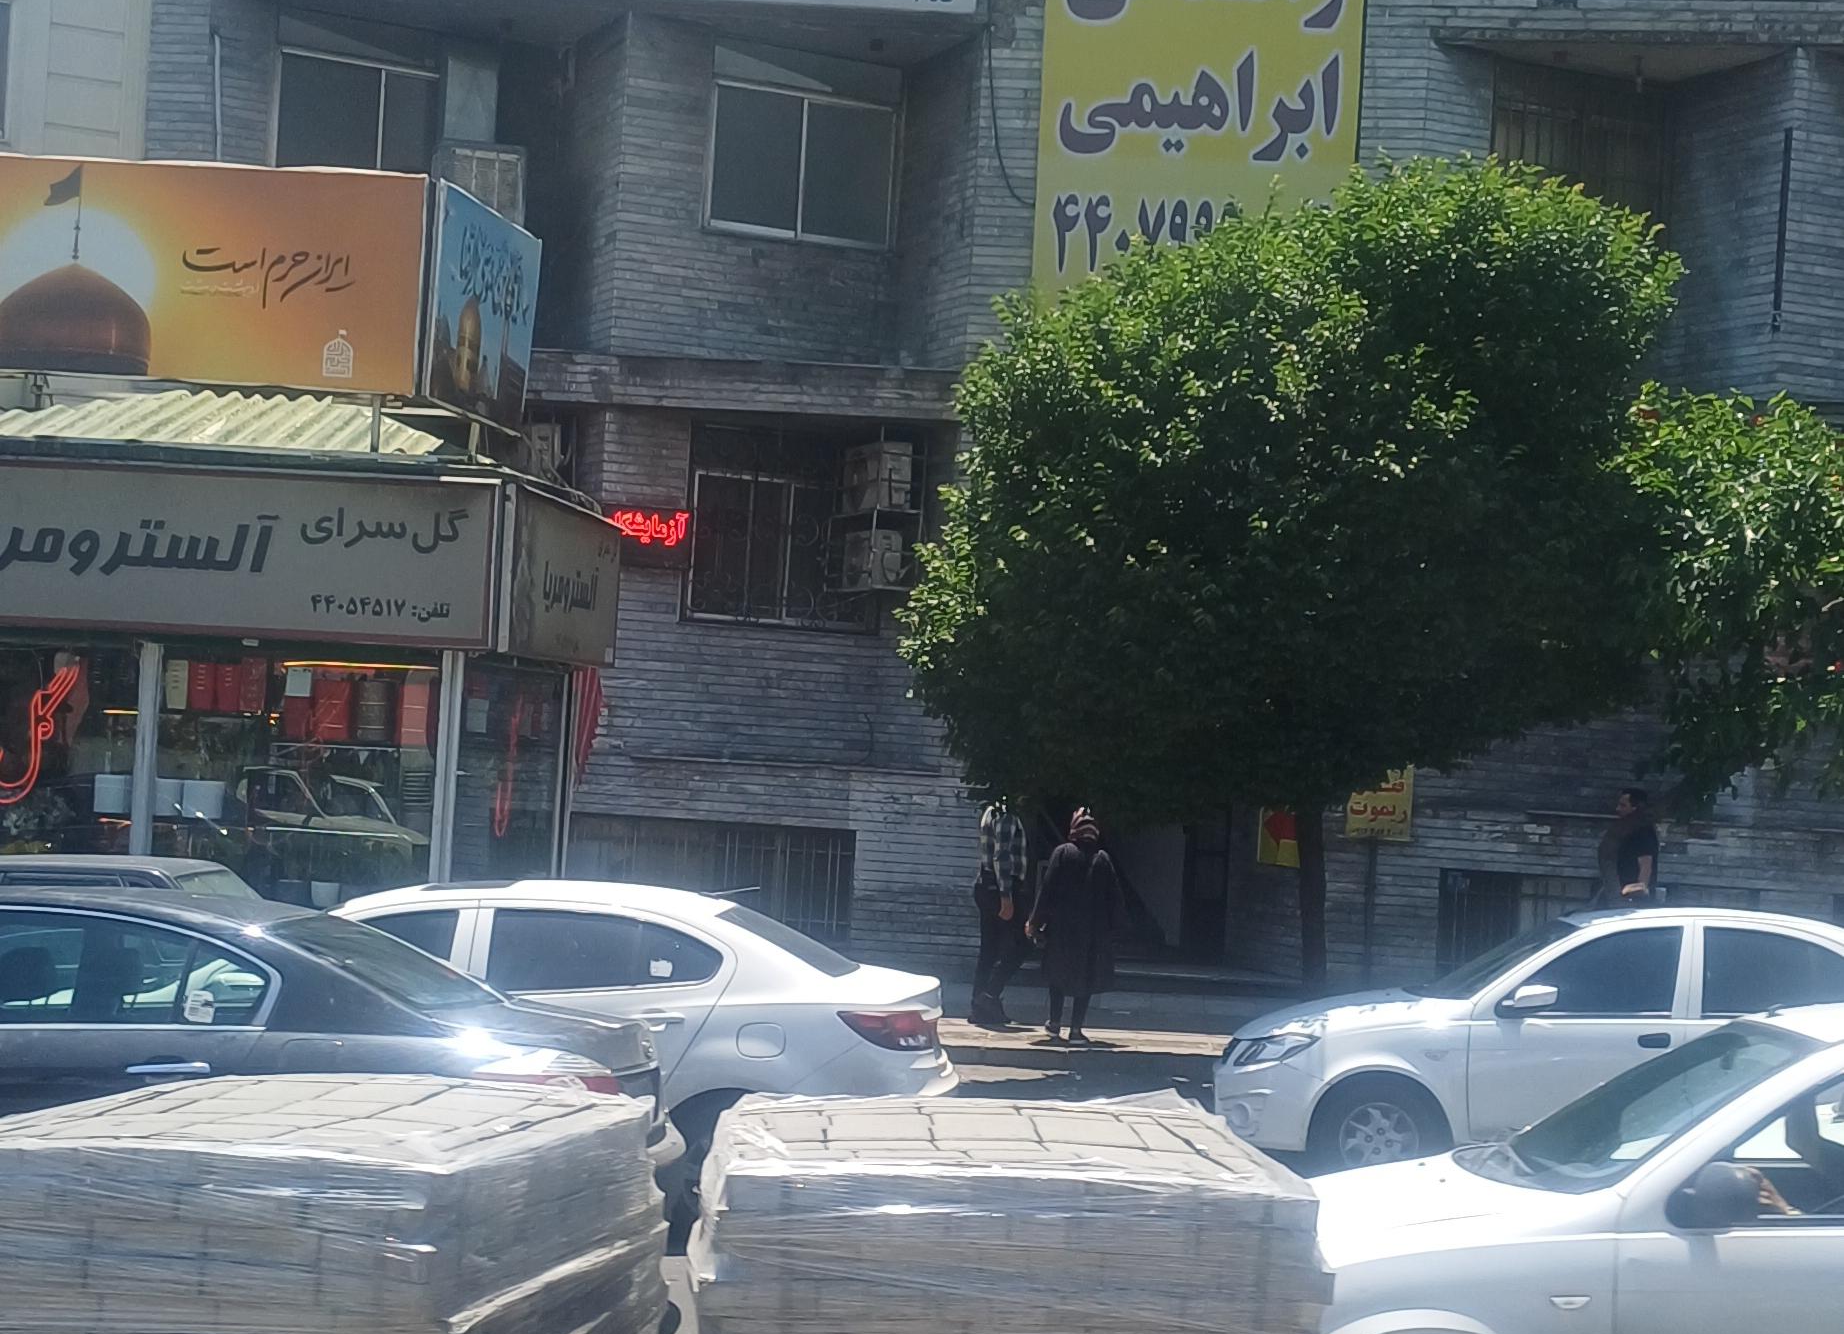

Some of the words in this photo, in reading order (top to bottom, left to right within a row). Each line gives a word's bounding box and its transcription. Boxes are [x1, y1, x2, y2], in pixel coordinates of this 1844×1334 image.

[1059, 50, 1340, 161] ابراهیمی
[181, 246, 266, 274] است
[0, 514, 281, 577] آلسترومر
[300, 507, 407, 549] سرای
[412, 509, 470, 554] گل
[613, 510, 690, 546] آزمایشگا
